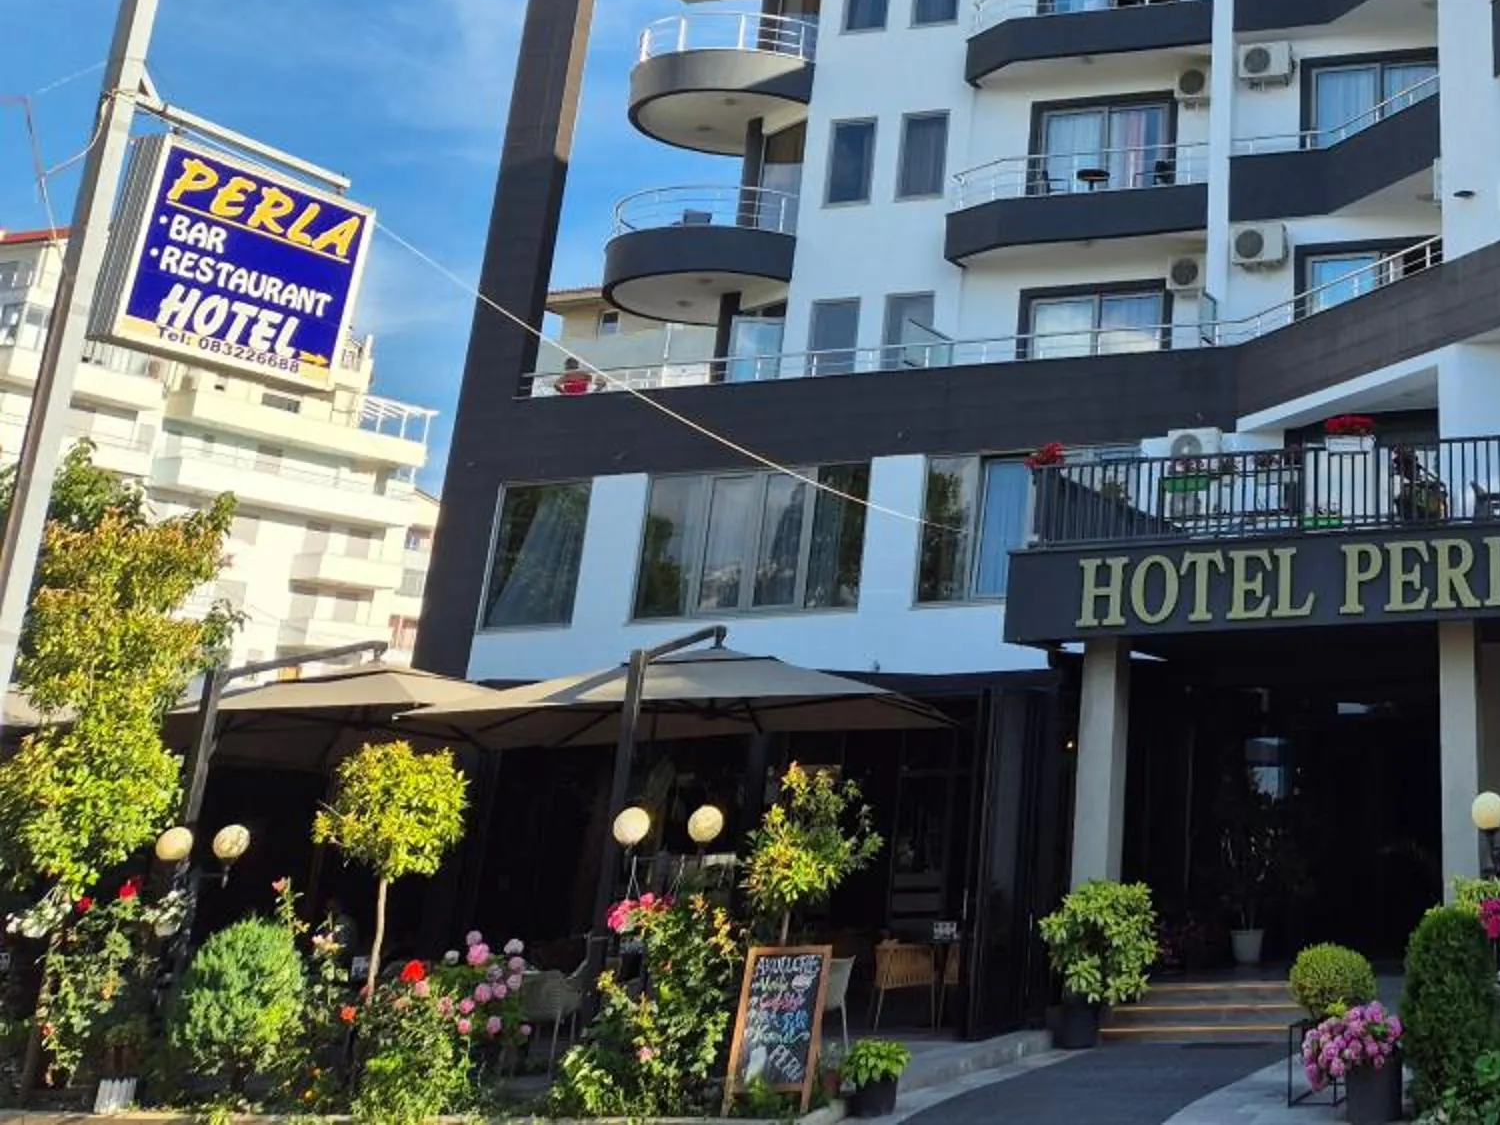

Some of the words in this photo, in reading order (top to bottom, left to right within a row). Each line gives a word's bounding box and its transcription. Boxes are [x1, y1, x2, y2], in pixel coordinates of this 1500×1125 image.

[167, 157, 362, 257] PERLA
[168, 214, 228, 254] BAR
[159, 246, 333, 317] RESTAURANT
[155, 283, 303, 358] HOTEL
[157, 325, 191, 346] Tel:
[1074, 546, 1315, 628] HOTEL
